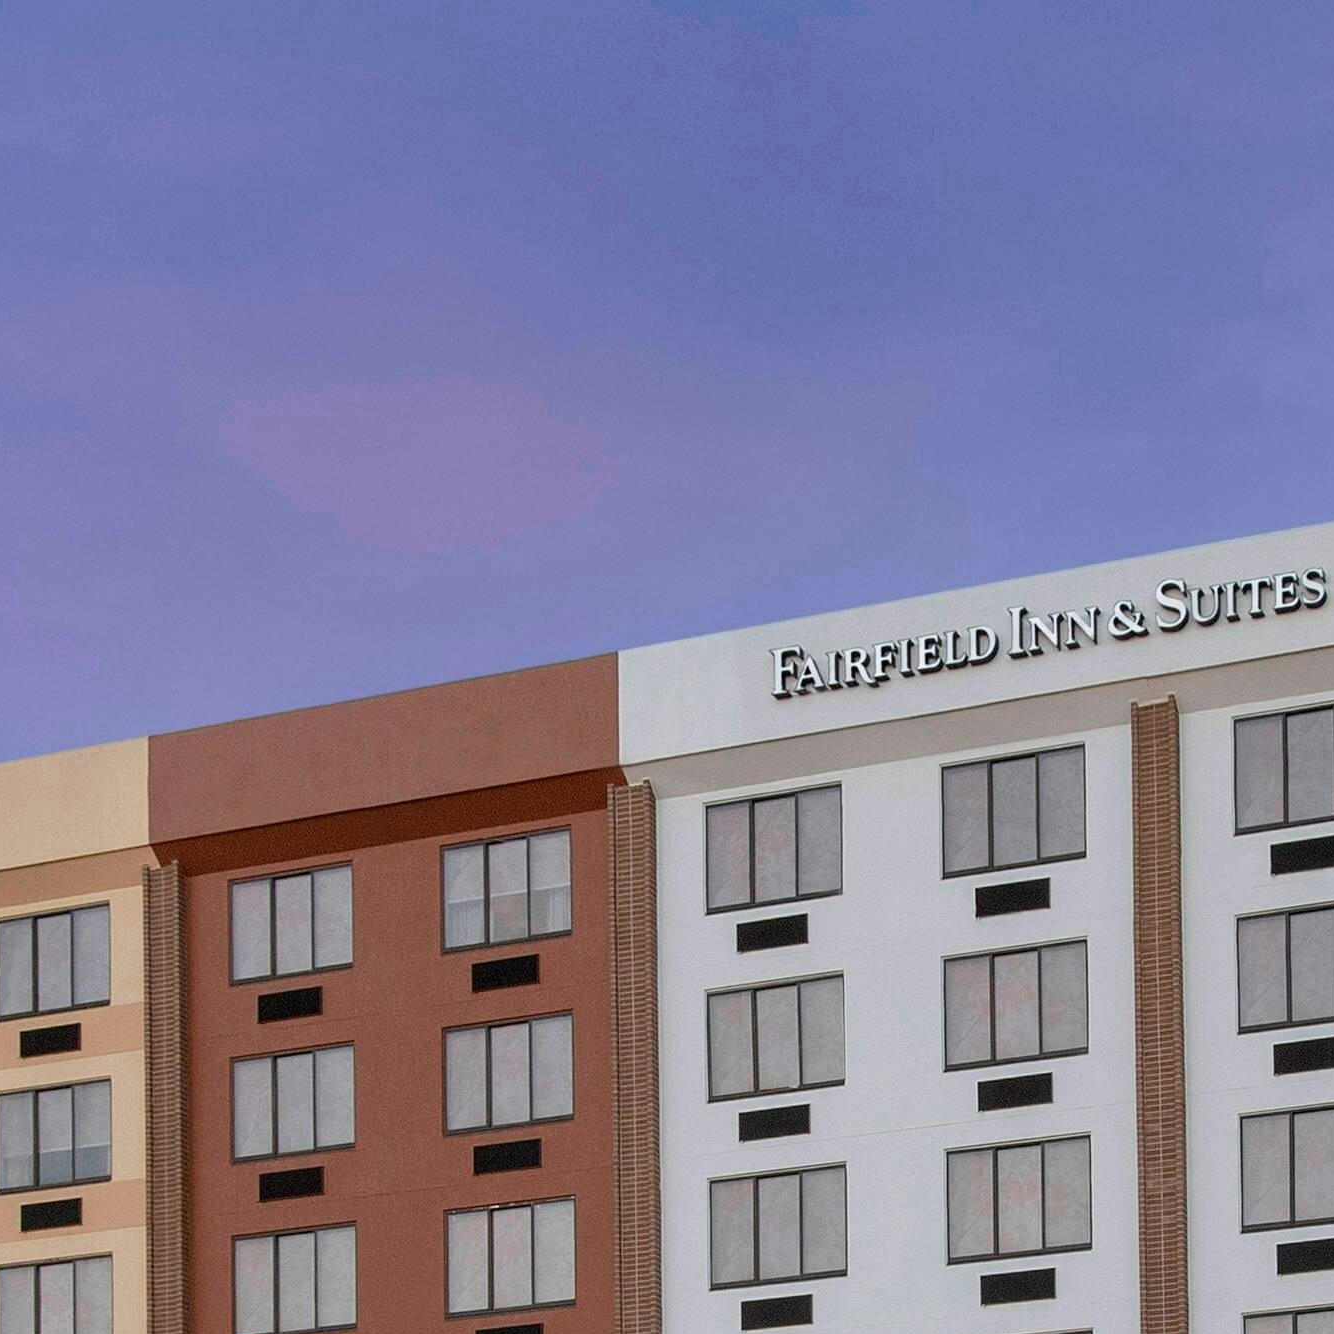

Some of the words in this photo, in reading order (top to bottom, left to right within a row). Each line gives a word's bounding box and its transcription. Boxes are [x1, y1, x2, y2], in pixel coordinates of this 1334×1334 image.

[770, 621, 1000, 700] FAIRFIELD
[1008, 604, 1101, 659] INN
[1107, 600, 1148, 641] &
[1155, 567, 1327, 633] SUITES
